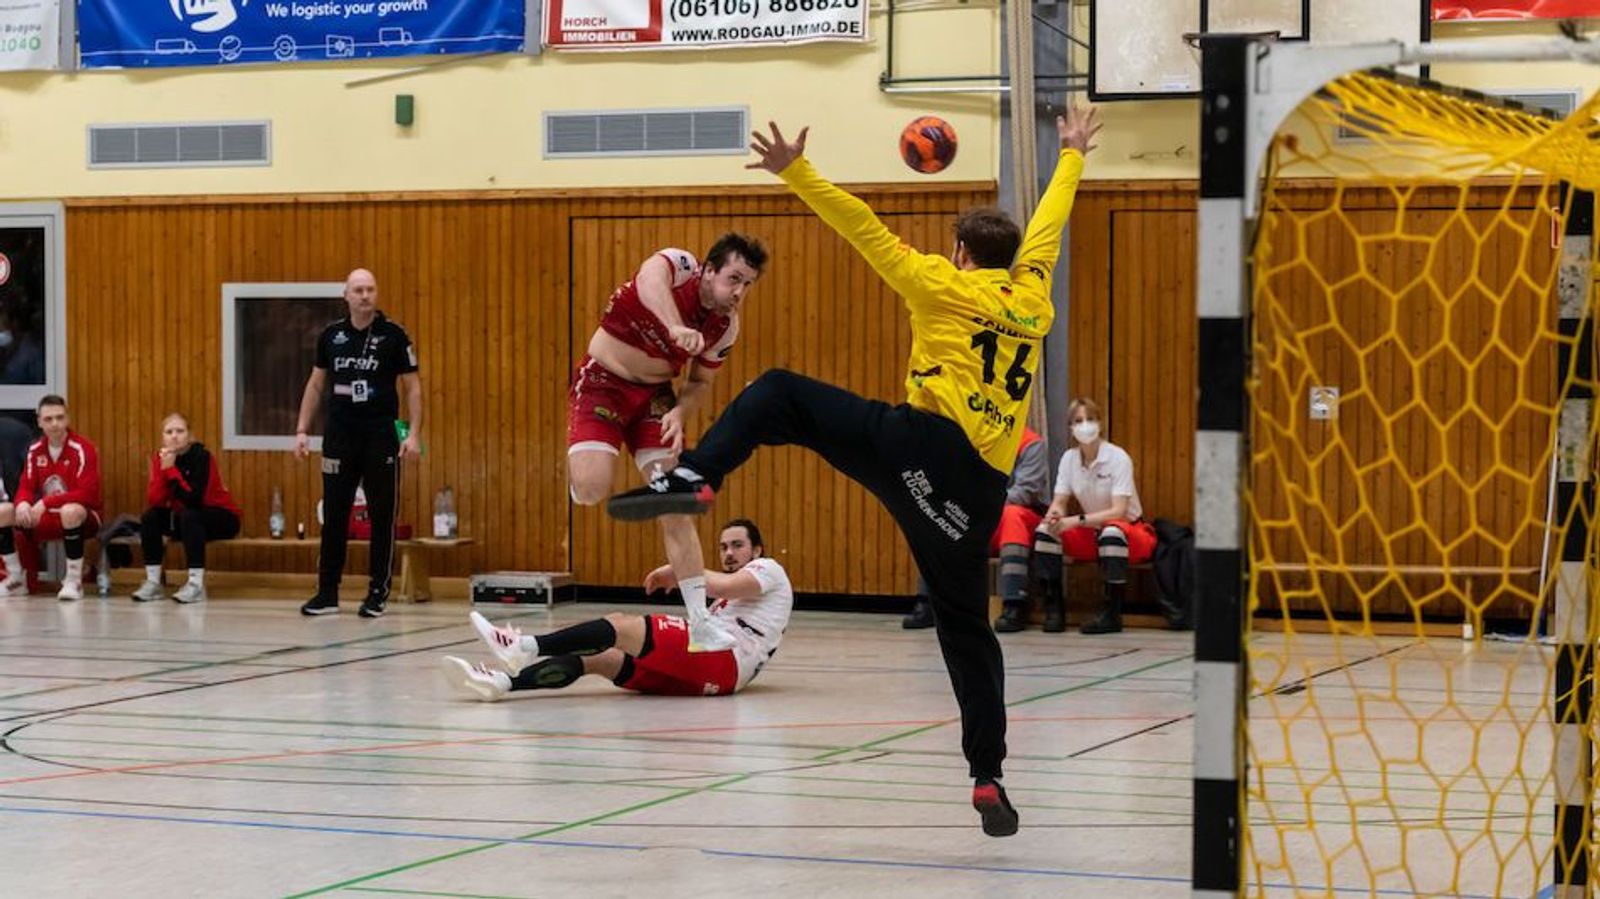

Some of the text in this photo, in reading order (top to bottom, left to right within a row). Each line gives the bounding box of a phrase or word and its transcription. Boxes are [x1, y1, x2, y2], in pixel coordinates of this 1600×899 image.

[266, 0, 428, 20] We logistic your growth
[670, 0, 759, 23] (06106)
[564, 17, 607, 27] HORCH
[671, 21, 860, 41] WWW.RODGAU-IMMO.DE
[562, 30, 637, 42] IMMOBILIEN
[970, 329, 1032, 401] 16
[355, 383, 365, 395] B
[912, 469, 934, 497] DER
